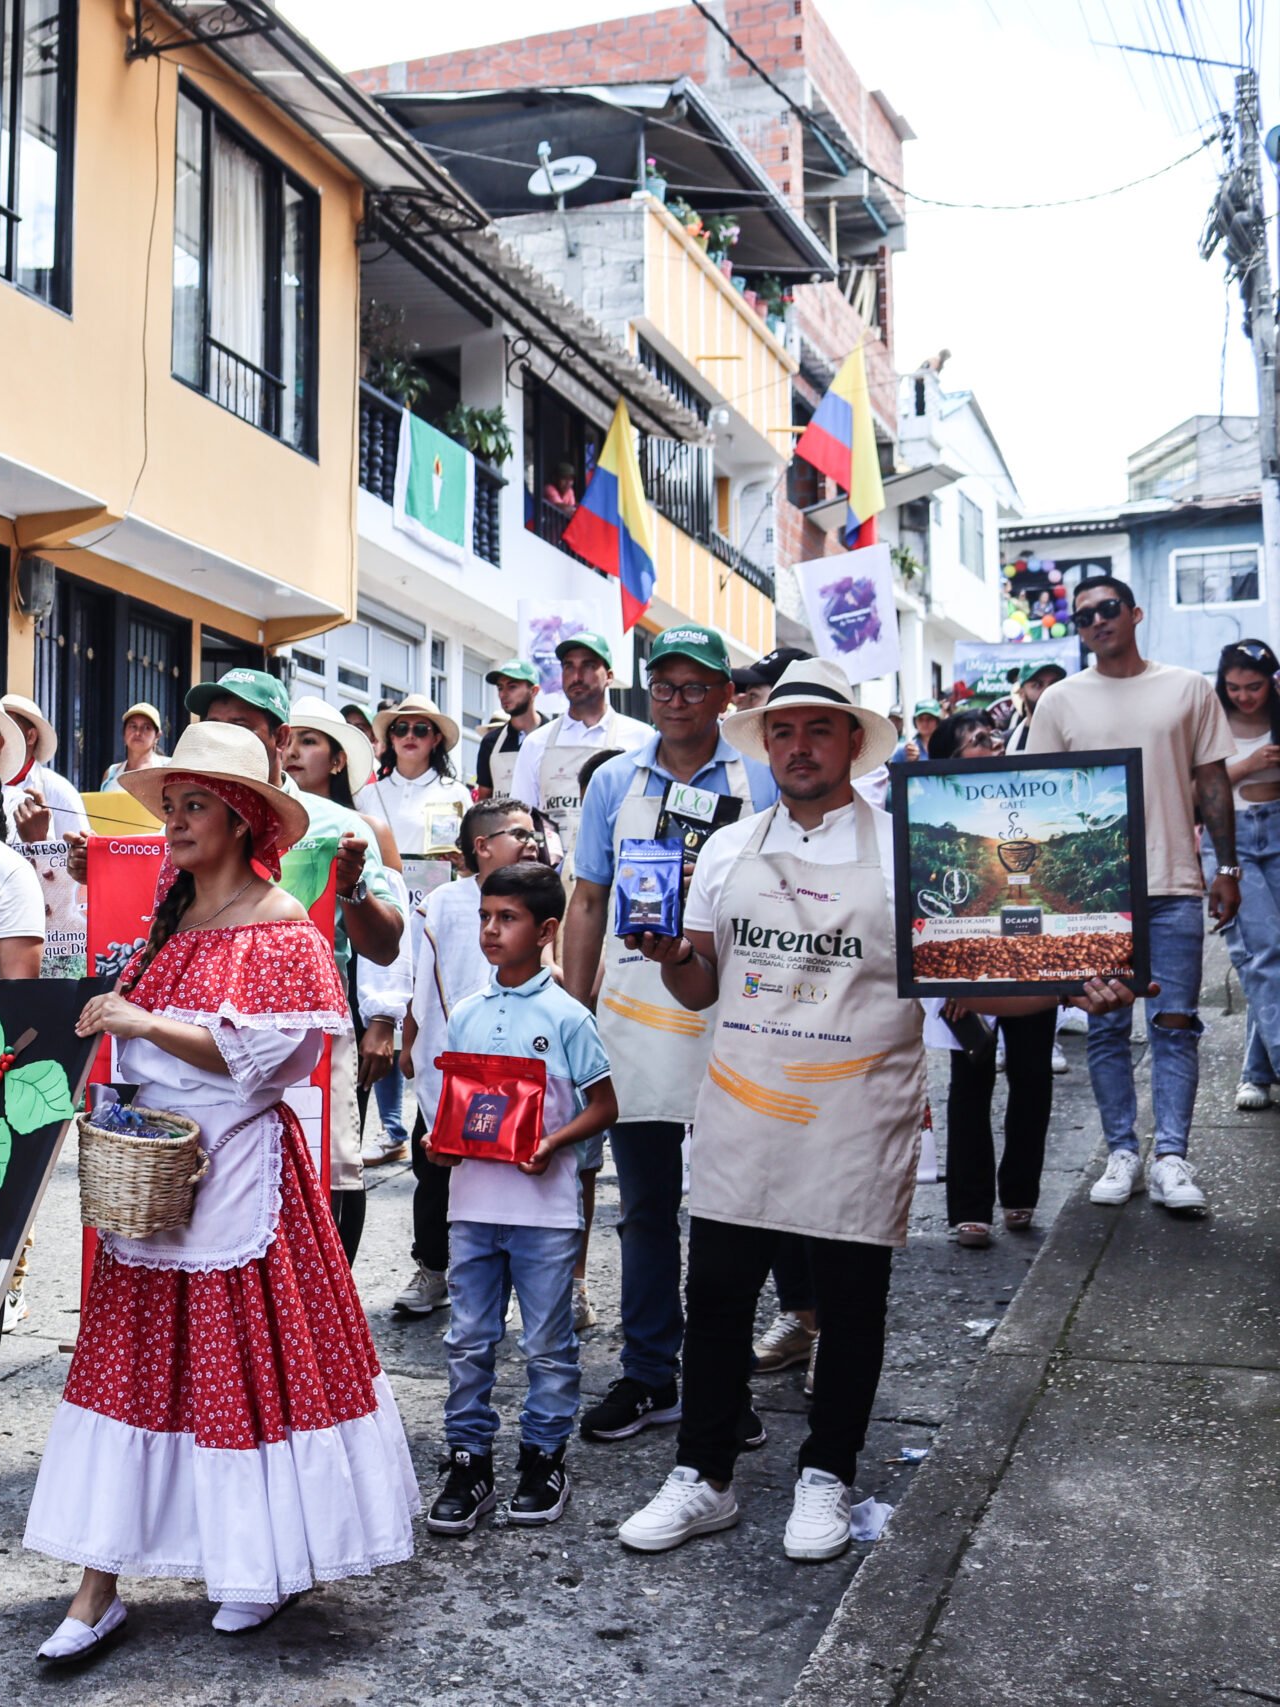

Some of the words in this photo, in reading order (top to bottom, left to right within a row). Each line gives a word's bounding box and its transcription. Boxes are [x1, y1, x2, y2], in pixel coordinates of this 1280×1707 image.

[965, 781, 1058, 801] DCAMPO
[31, 843, 71, 856] TESO
[109, 840, 161, 856] Conoce
[49, 855, 67, 868] Ca
[797, 888, 829, 899] FONTUR
[46, 930, 86, 943] idamo
[731, 917, 864, 960] Herencia
[44, 946, 67, 959] que
[733, 949, 751, 957] FERIA
[751, 951, 785, 961] CULTURAL
[748, 958, 785, 969] ARTESANAL
[791, 963, 832, 974] CAFETERA
[1037, 968, 1098, 977] Marquetalia
[722, 1021, 750, 1032] COLOMBIA
[761, 1026, 770, 1034] EL
[791, 1030, 802, 1038] DE
[818, 1033, 853, 1043] BELLEZA
